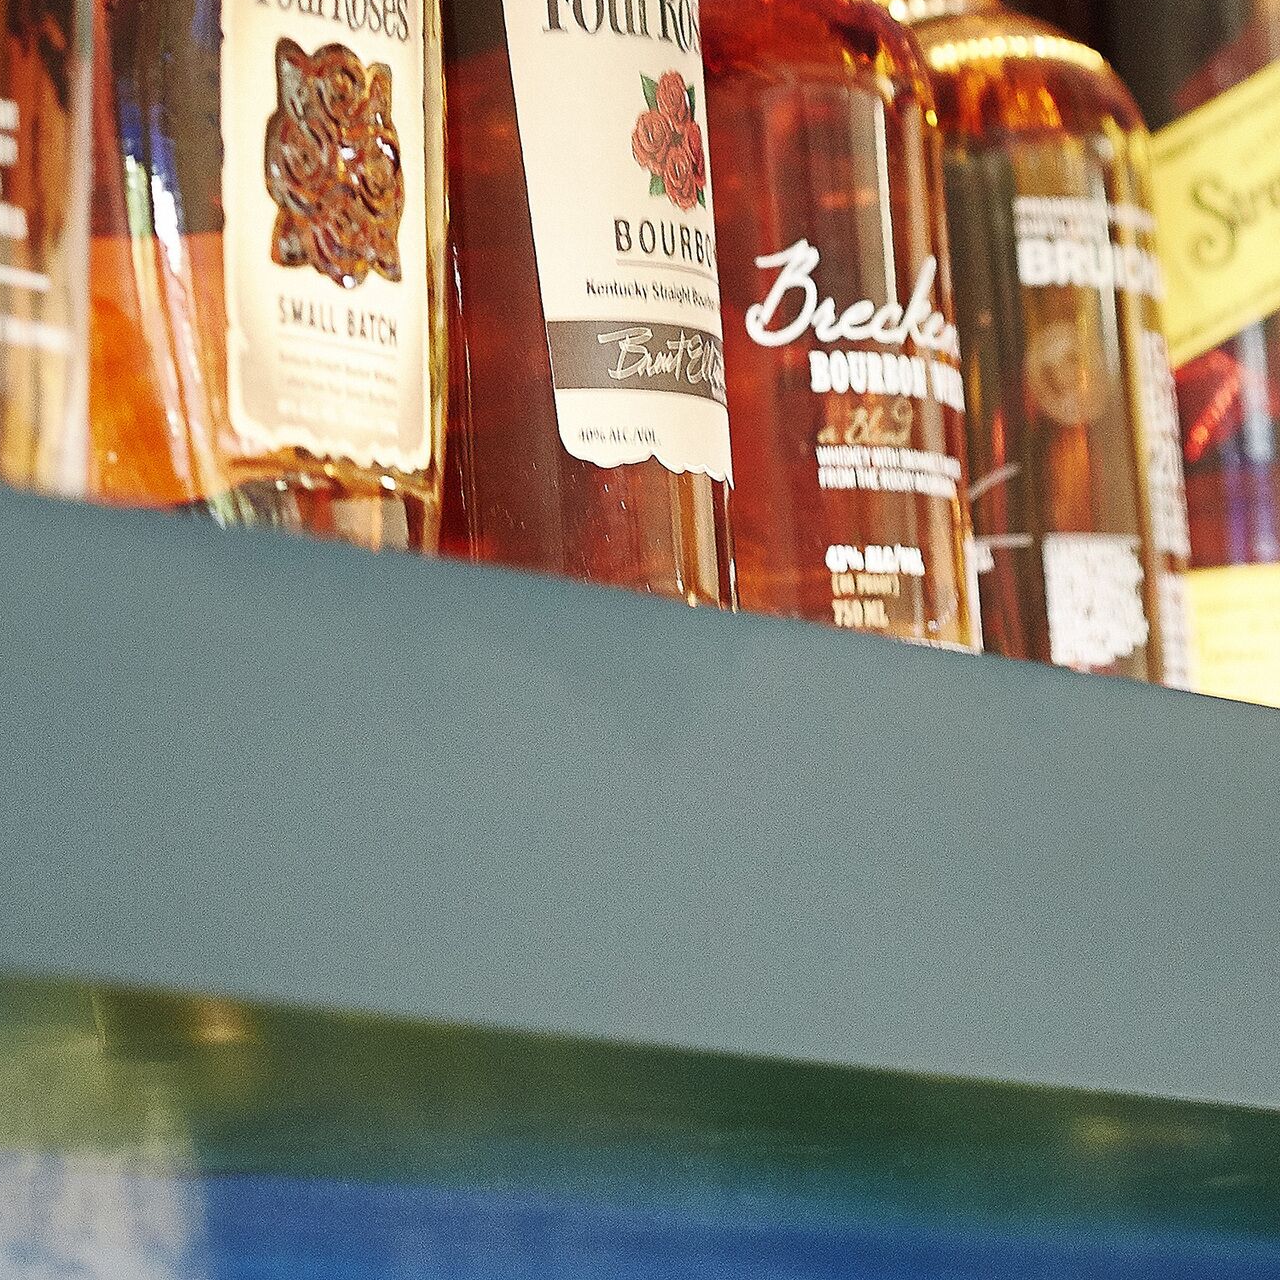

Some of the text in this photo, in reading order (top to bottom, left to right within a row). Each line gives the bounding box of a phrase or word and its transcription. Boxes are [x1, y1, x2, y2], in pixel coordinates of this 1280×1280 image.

[585, 278, 648, 303] Kentucky
[278, 293, 399, 348] SMALL BATCH
